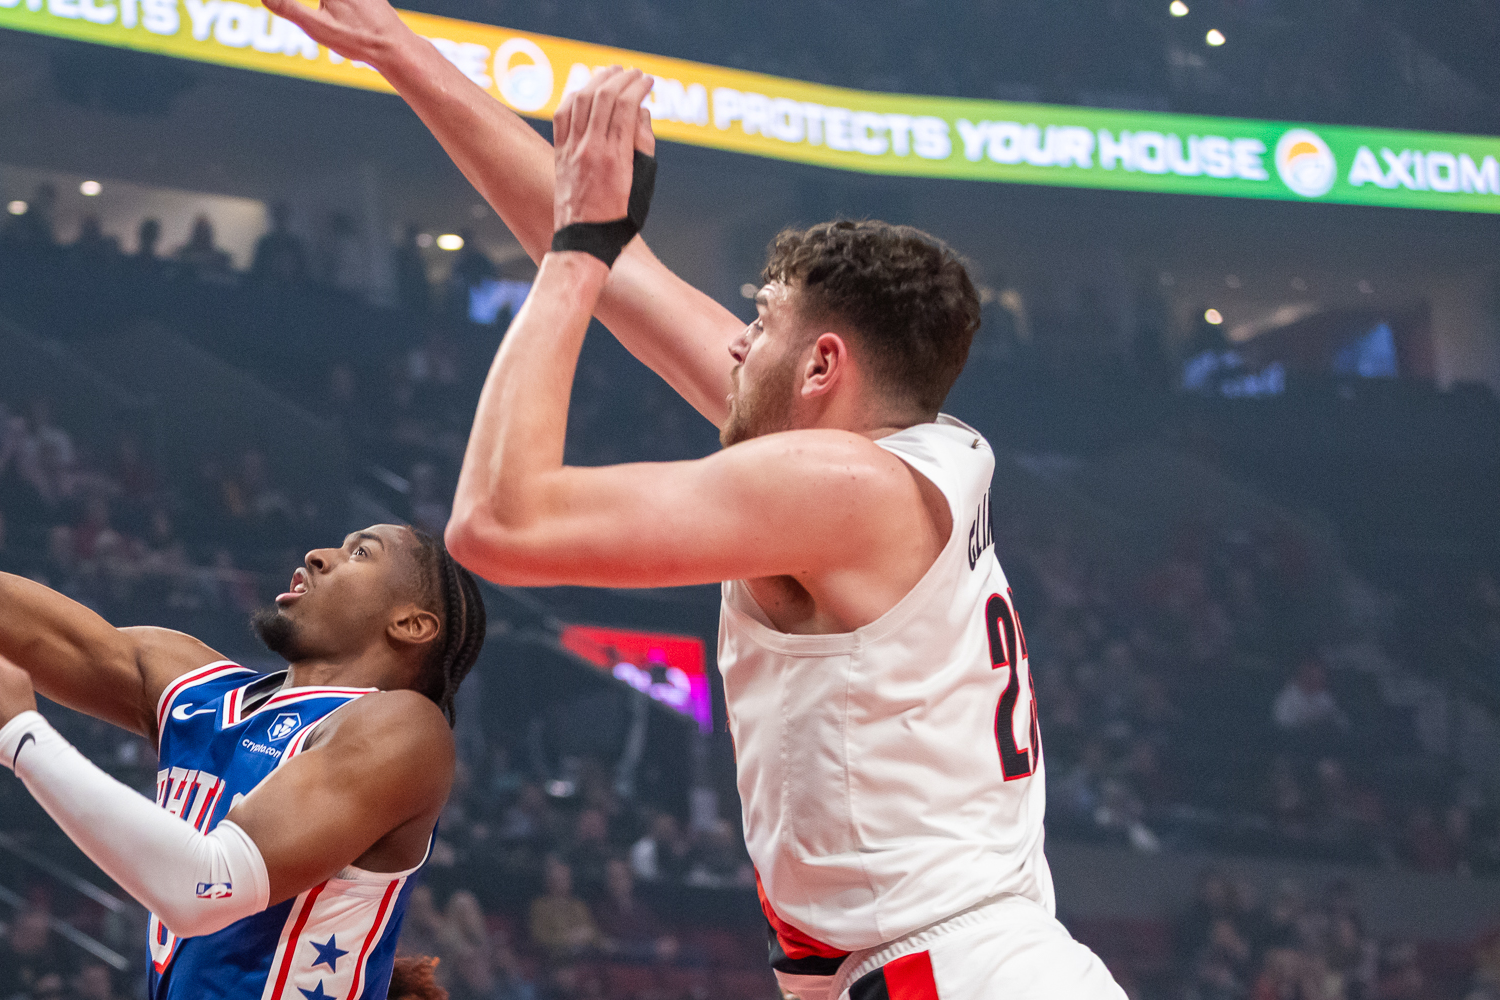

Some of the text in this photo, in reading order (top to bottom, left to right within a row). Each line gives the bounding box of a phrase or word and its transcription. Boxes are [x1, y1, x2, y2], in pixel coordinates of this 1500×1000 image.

[711, 86, 950, 160] PROTECTS
[955, 117, 1095, 170] YOUR
[1096, 127, 1270, 182] HOUSE
[1348, 145, 1500, 195] AXIOM
